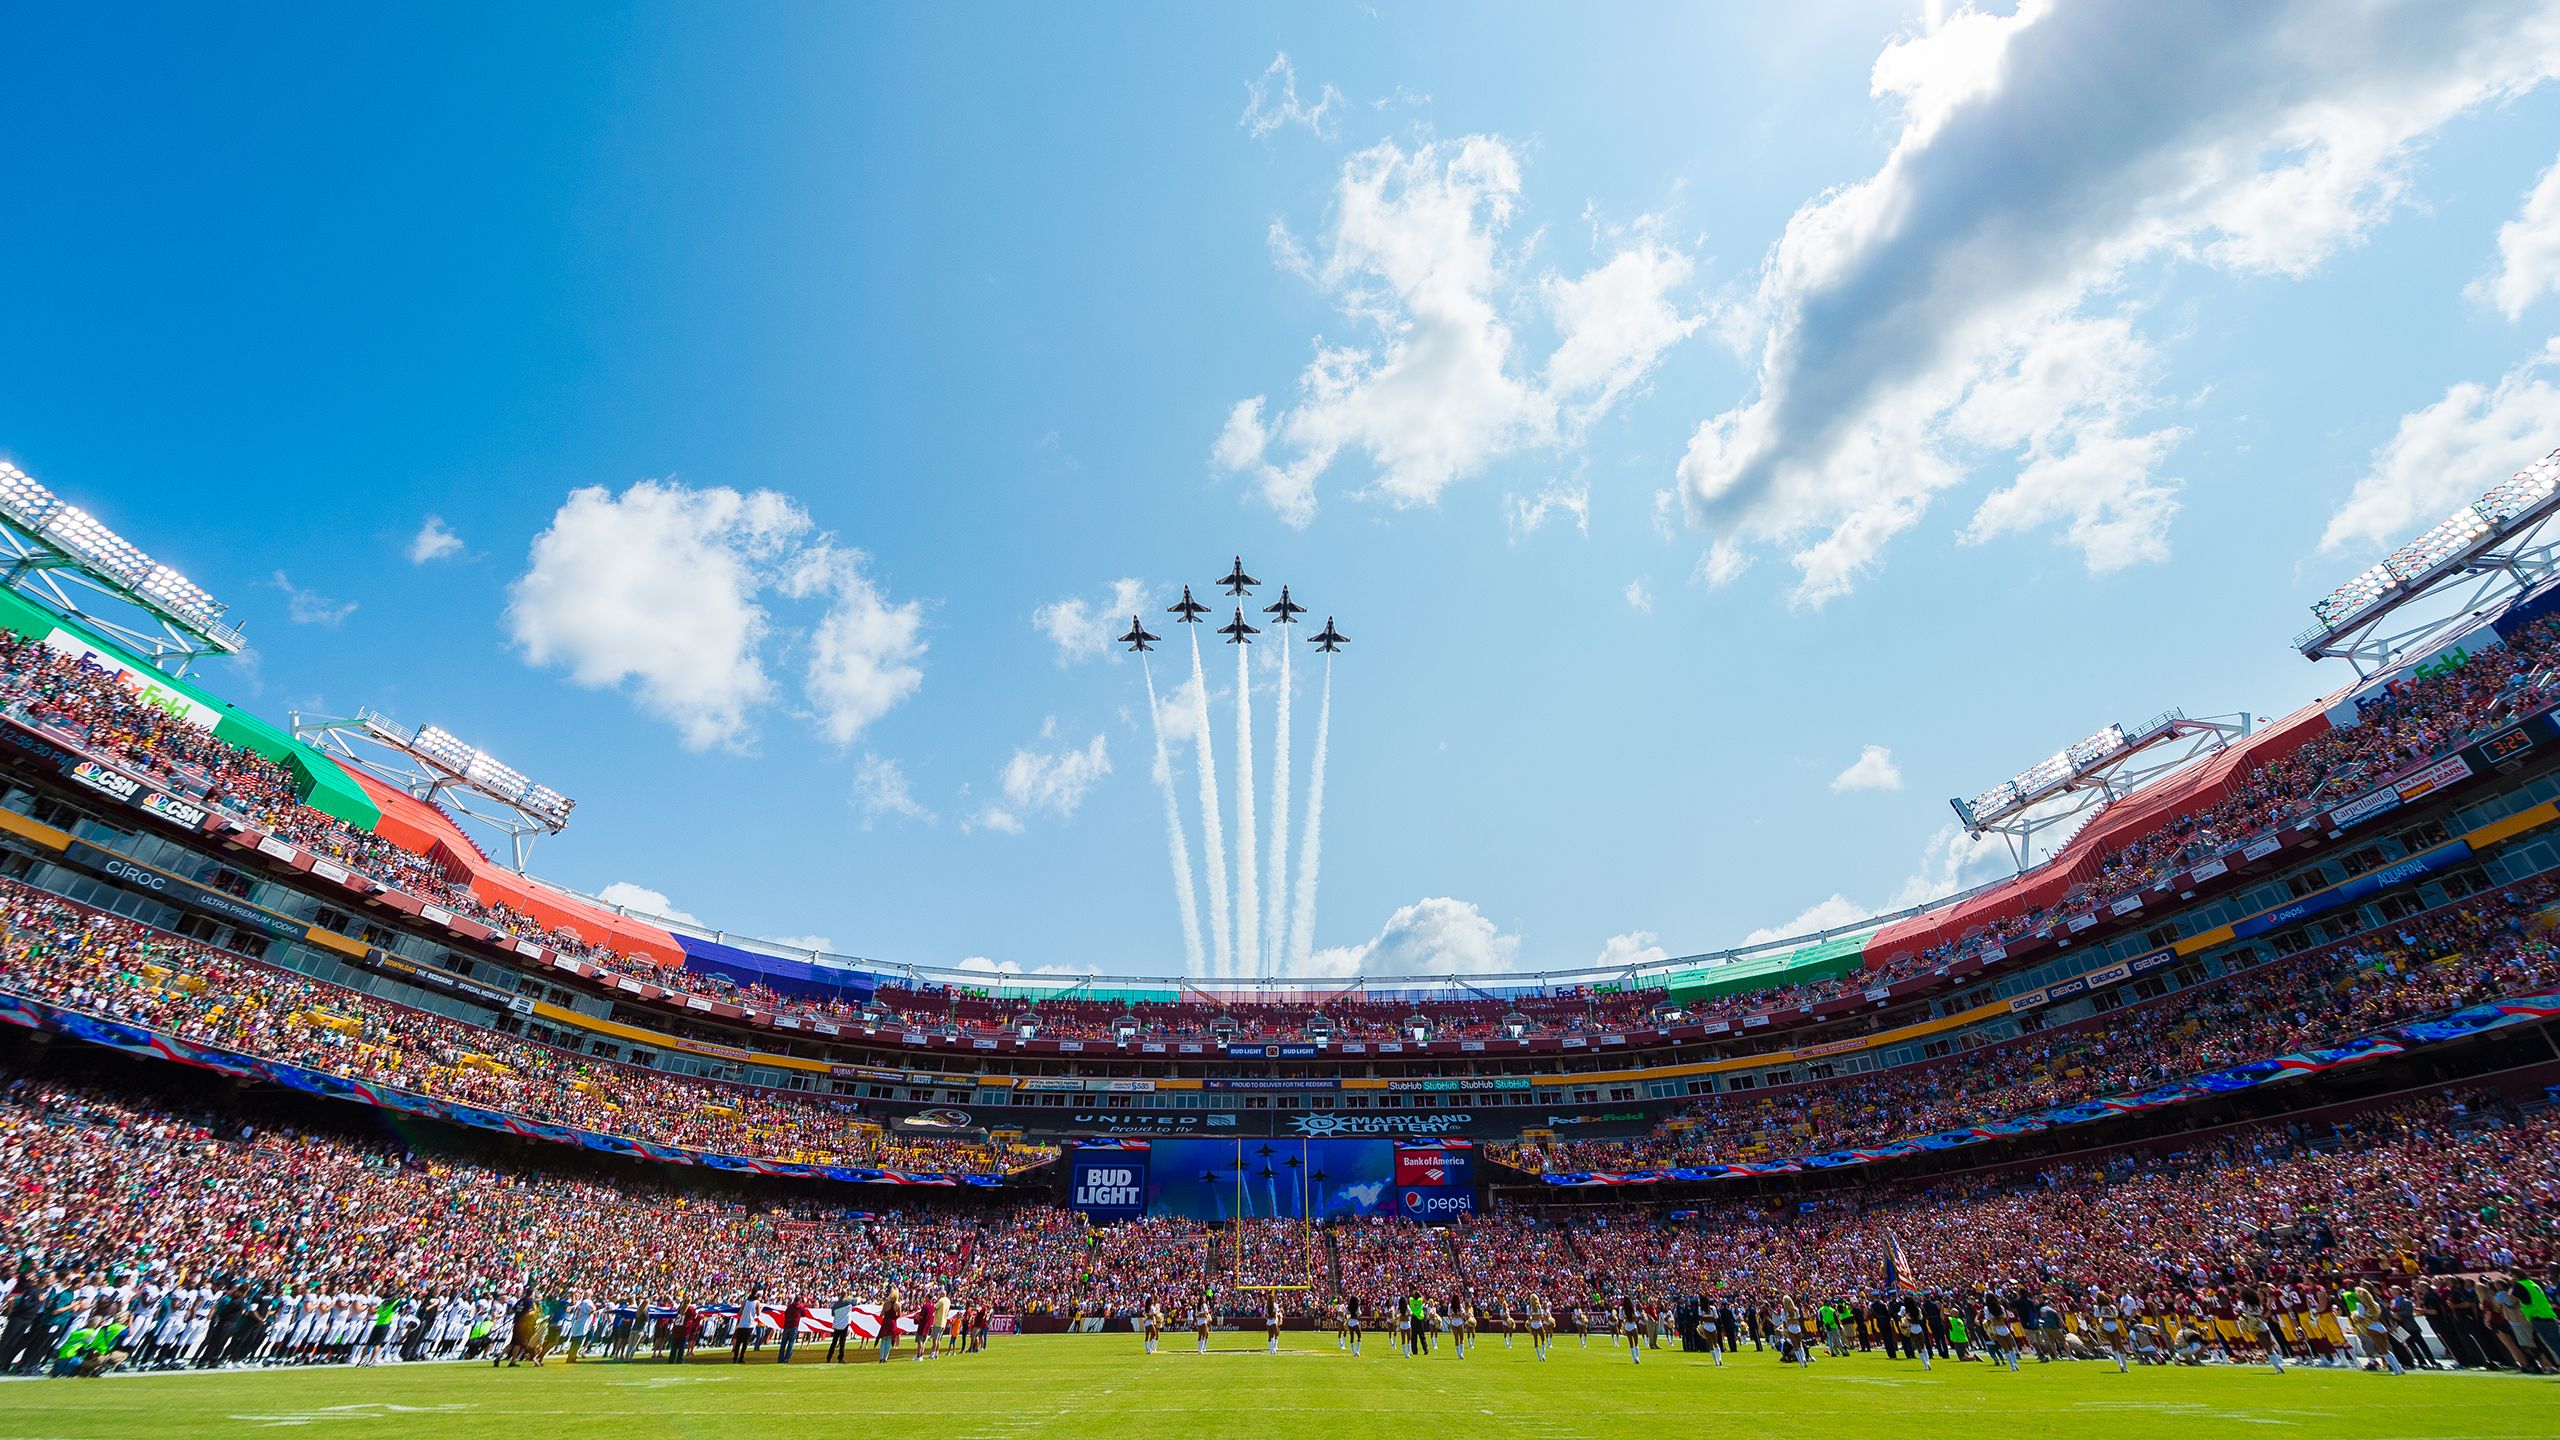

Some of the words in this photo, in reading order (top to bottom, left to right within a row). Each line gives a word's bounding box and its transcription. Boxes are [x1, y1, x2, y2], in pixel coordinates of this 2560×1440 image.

[2493, 731, 2529, 755] 3:29
[2431, 764, 2466, 783] LEARN
[98, 770, 141, 797] CSN
[2402, 781, 2433, 799] Support
[166, 800, 206, 825] CSN
[2333, 791, 2384, 821] Carpetland
[2377, 859, 2427, 888] AQUAFINA
[201, 895, 229, 911] ULTRA
[230, 904, 271, 924] PREMIUM
[272, 918, 299, 935] VODKA
[2279, 905, 2305, 922] pepsi
[2133, 952, 2170, 971] GEICO
[2091, 968, 2125, 985] GEICO
[2051, 981, 2084, 998] GEICO
[2013, 994, 2043, 1009] GEICO
[1389, 1081, 1422, 1091] StubHub
[1423, 1081, 1457, 1091] StubHub
[1460, 1080, 1494, 1089] StubHub
[1495, 1079, 1530, 1089] StubHub
[1075, 1115, 1198, 1124] UNITED
[1351, 1114, 1472, 1124] MARYLAND
[1351, 1123, 1451, 1132] LOTTERY
[1549, 1112, 1645, 1126] FedExField
[1109, 1125, 1152, 1133] Proud
[1403, 1156, 1424, 1166] Bank
[1424, 1156, 1433, 1165] of
[1432, 1156, 1465, 1166] America
[1087, 1168, 1132, 1187] BUD
[1077, 1186, 1139, 1206] LIGHT
[1427, 1194, 1471, 1213] pepsi
